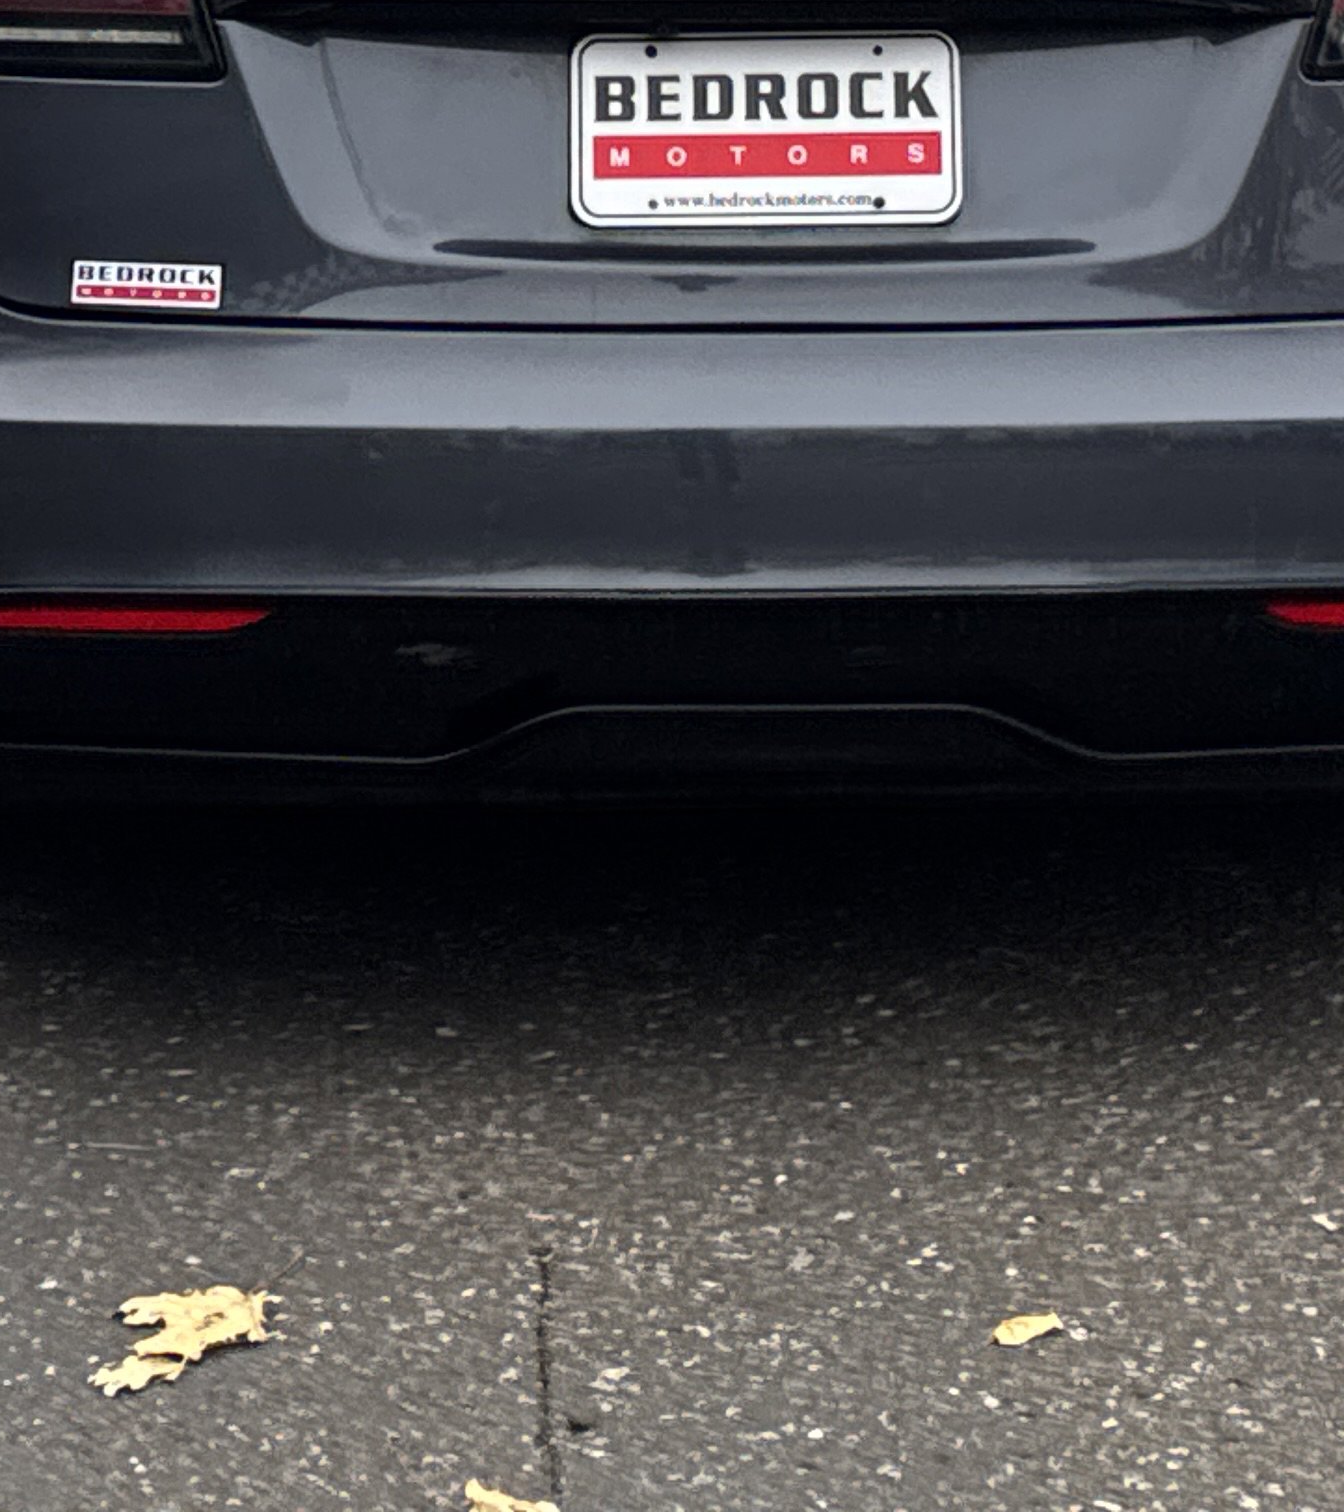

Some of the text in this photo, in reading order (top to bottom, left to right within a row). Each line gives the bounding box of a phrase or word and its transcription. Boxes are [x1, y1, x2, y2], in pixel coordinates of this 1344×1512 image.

[593, 71, 939, 122] BEDROCK
[609, 143, 925, 168] MOTORS
[663, 191, 873, 208] www.bedrockmotors.com
[77, 265, 215, 285] BEDROCK
